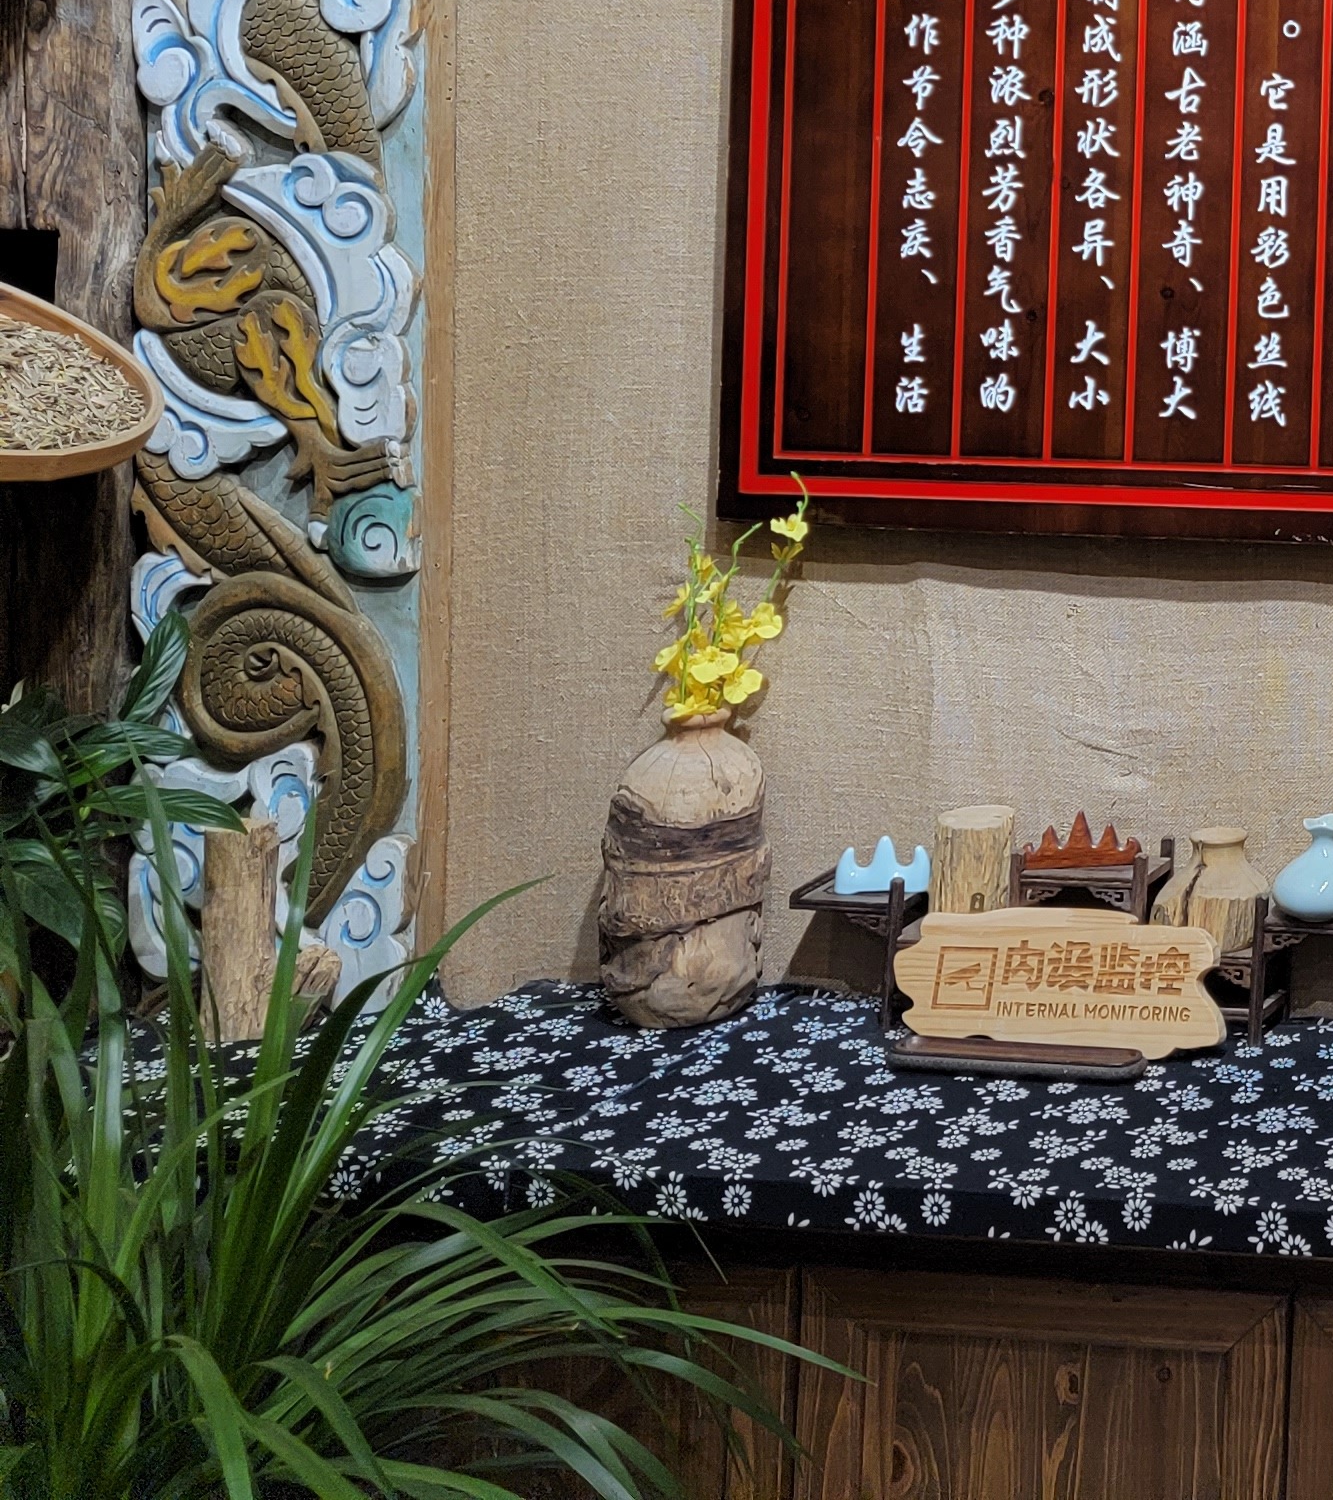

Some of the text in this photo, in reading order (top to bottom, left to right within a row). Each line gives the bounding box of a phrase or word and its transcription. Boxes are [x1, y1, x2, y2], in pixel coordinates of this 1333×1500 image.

[1001, 940, 1191, 996] 内设监控
[996, 1001, 1191, 1022] INTERNAL MONITORING
